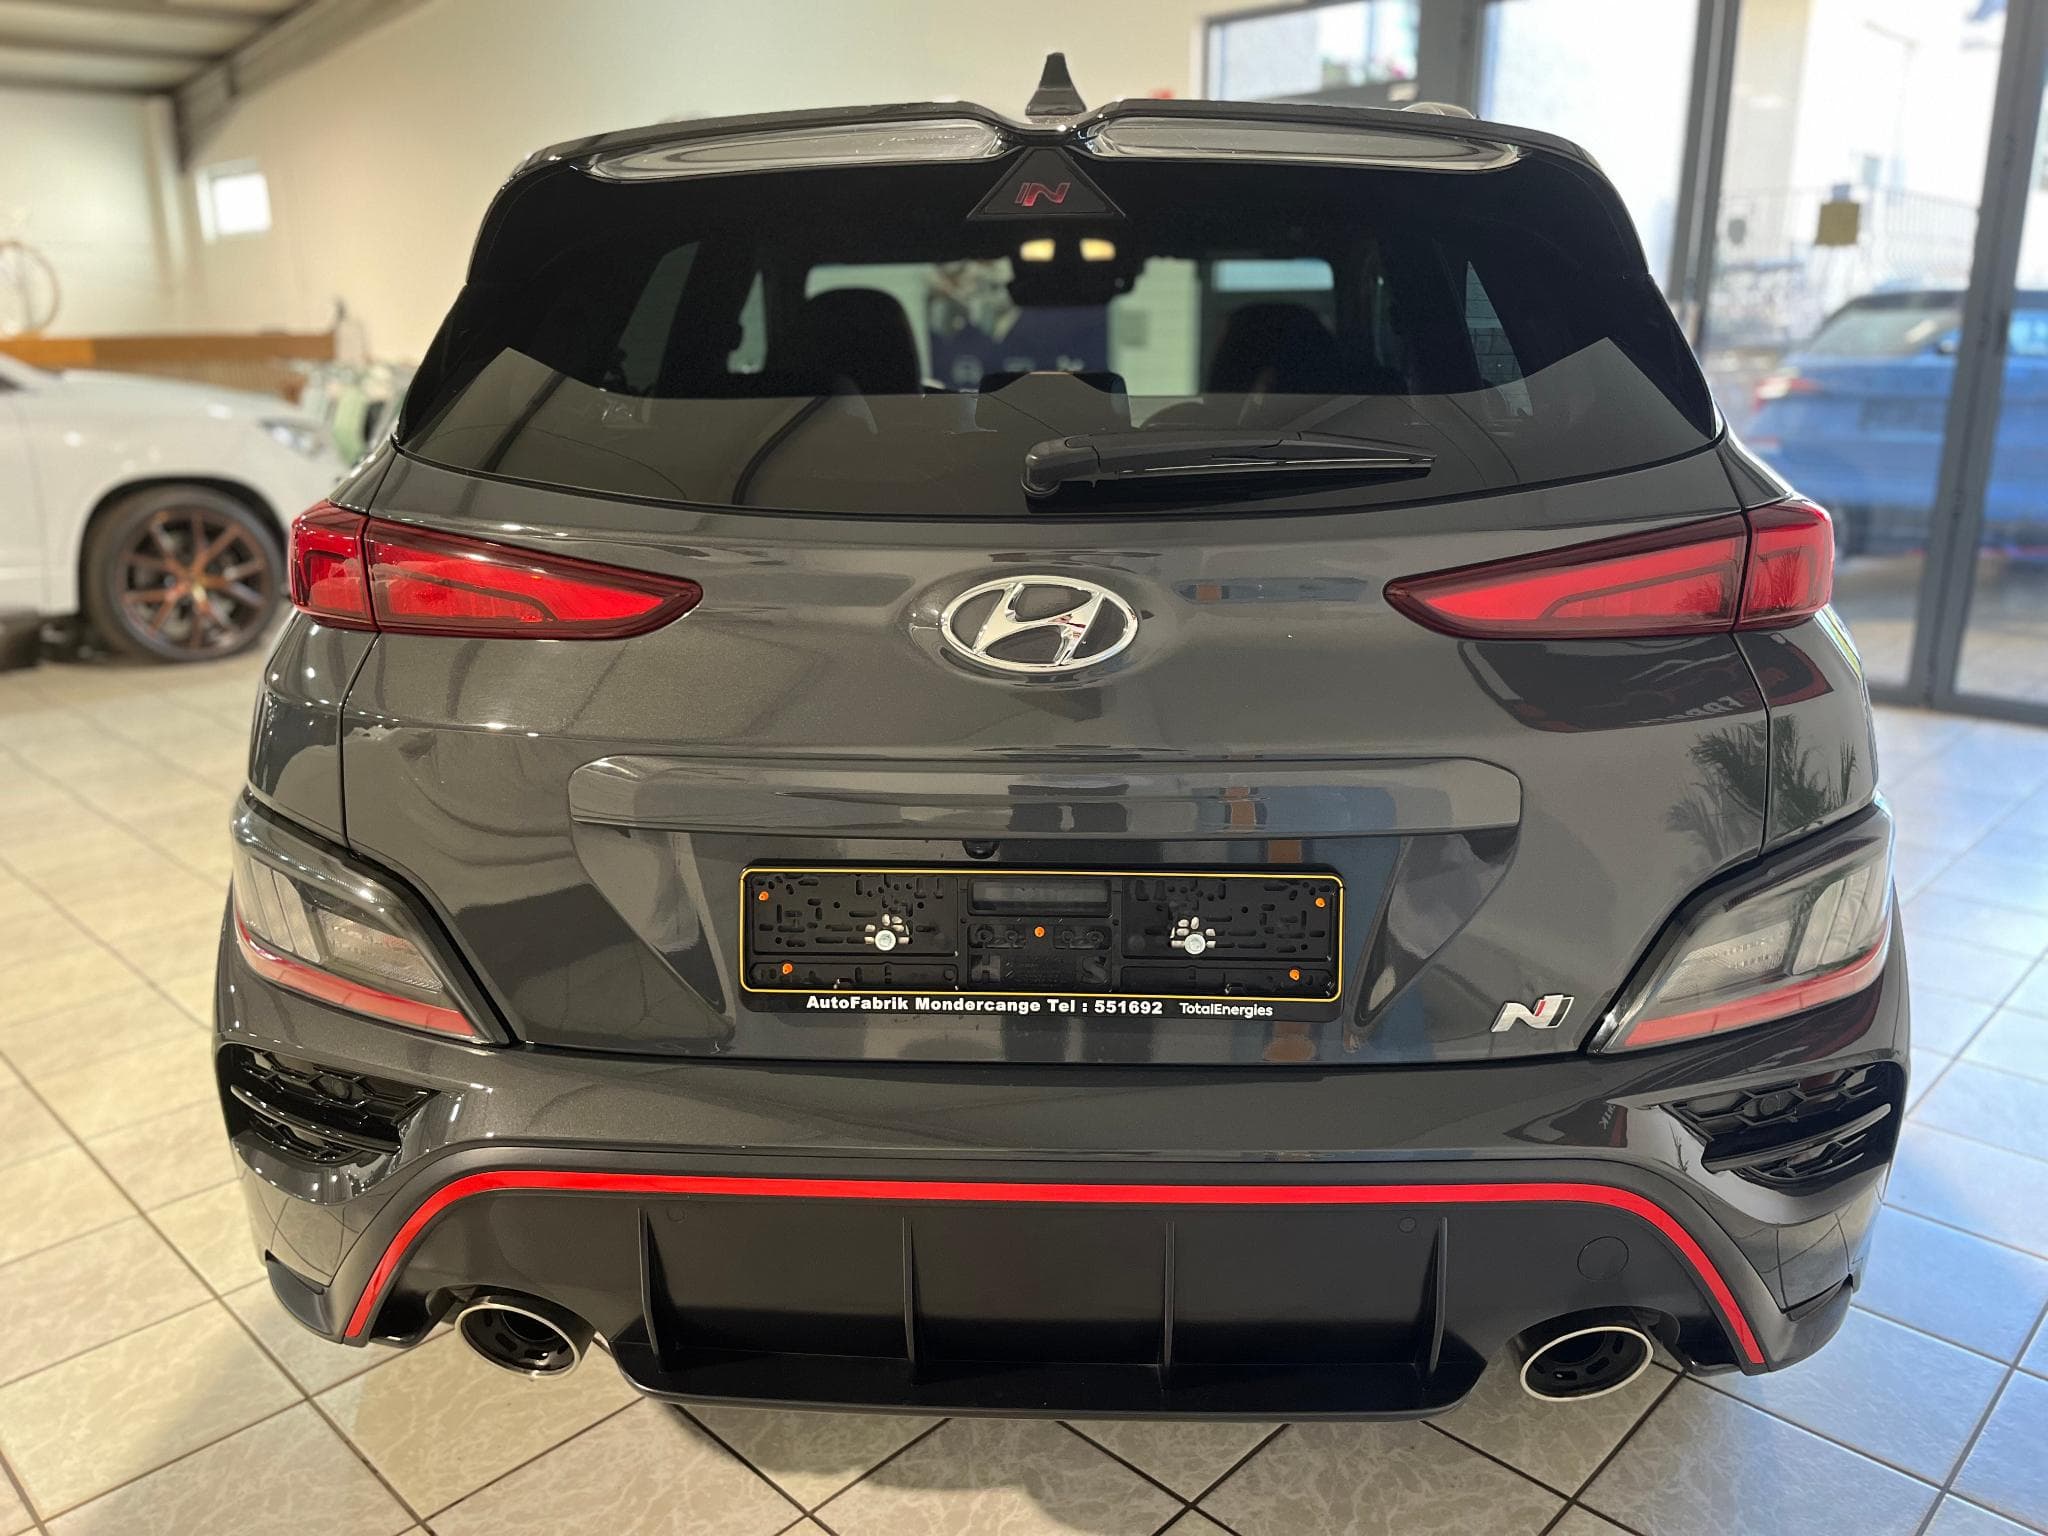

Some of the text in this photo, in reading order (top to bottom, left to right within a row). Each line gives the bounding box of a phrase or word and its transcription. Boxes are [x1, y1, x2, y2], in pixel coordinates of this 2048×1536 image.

[806, 996, 908, 1010] AutoFabrik
[915, 997, 1041, 1014] Mondercange
[1047, 999, 1075, 1013] Tel
[1094, 1000, 1163, 1015] 551692
[1179, 1002, 1273, 1018] TotalEnergies
